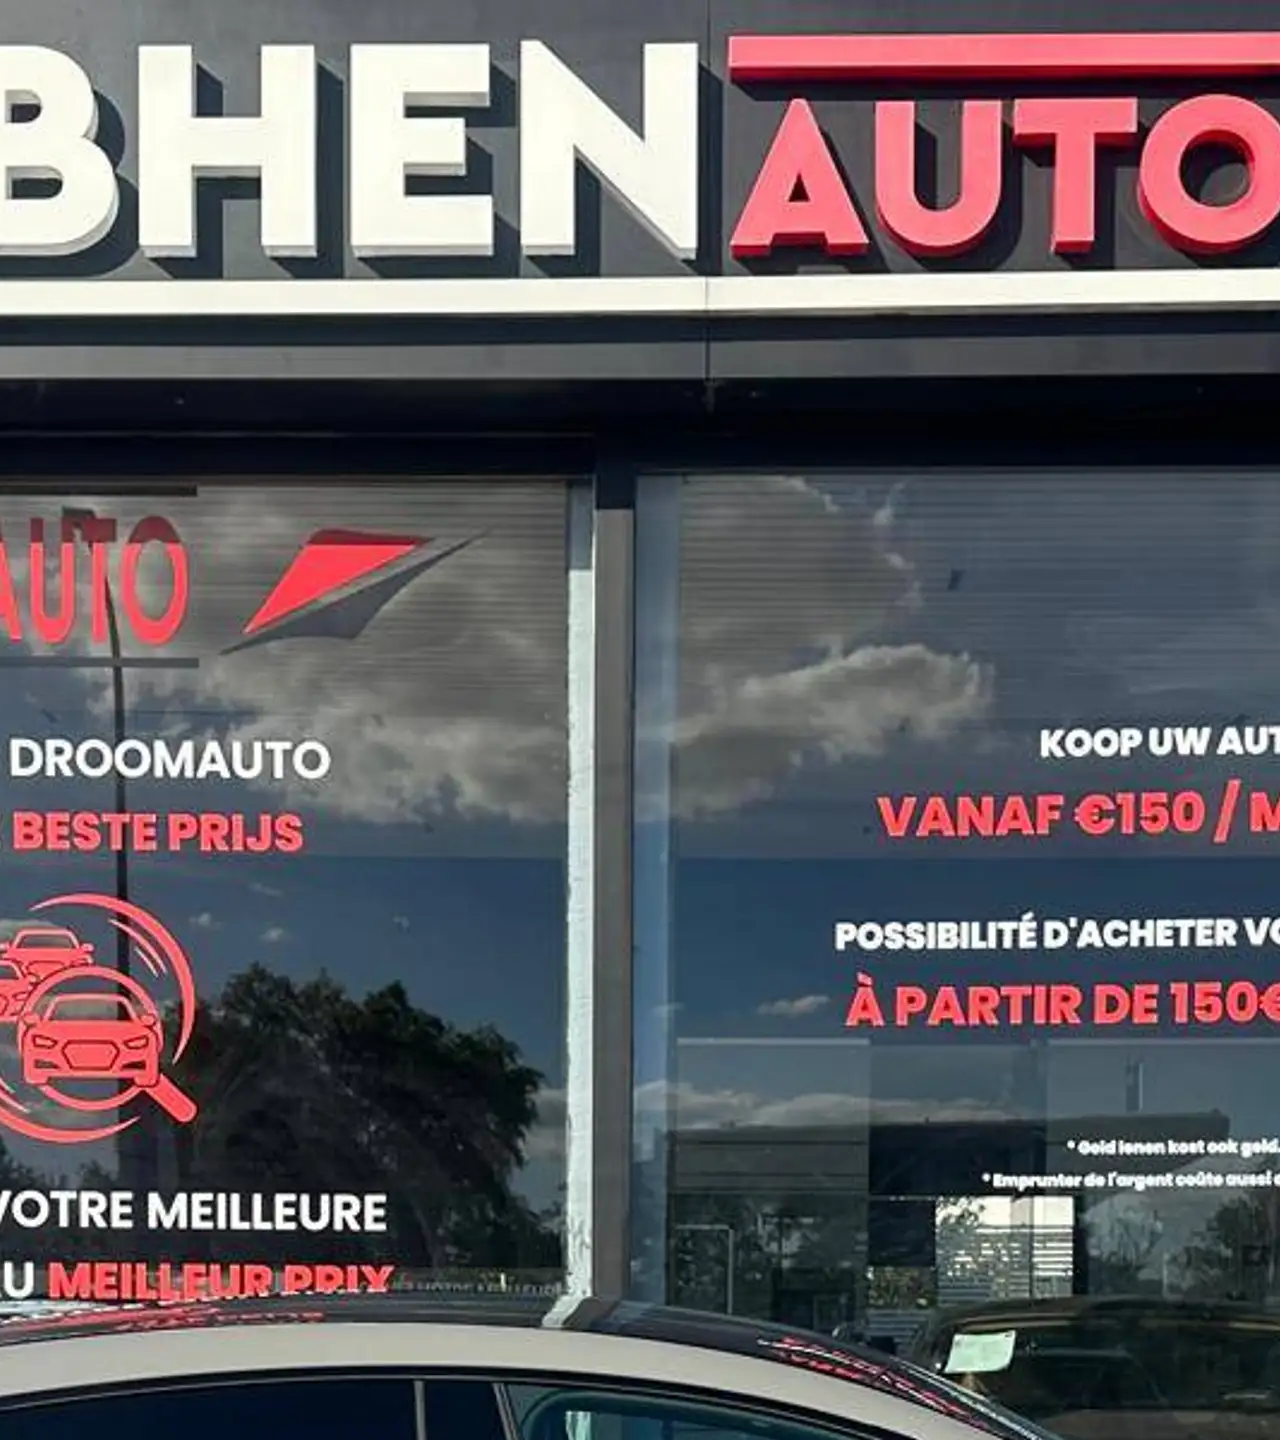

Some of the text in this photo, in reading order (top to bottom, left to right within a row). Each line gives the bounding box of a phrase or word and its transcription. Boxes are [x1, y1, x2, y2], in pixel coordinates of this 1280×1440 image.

[10, 738, 331, 780] DROOMAUTO
[1040, 728, 1140, 758] KOOP
[1149, 727, 1211, 756] UW
[13, 811, 156, 851] BESTE
[167, 812, 304, 853] PRIJS
[878, 795, 1064, 837] VANAF
[1074, 791, 1206, 835] €150
[836, 912, 1037, 950] POSSIBILITÉ
[1043, 916, 1238, 949] D'ACHETER
[846, 972, 884, 1026] À
[895, 984, 1083, 1026] PARTIR
[1093, 983, 1158, 1024] DE
[148, 1192, 387, 1231] MEILLEURE
[48, 1262, 273, 1303] MEILLEUR
[281, 1264, 394, 1295] PRIX
